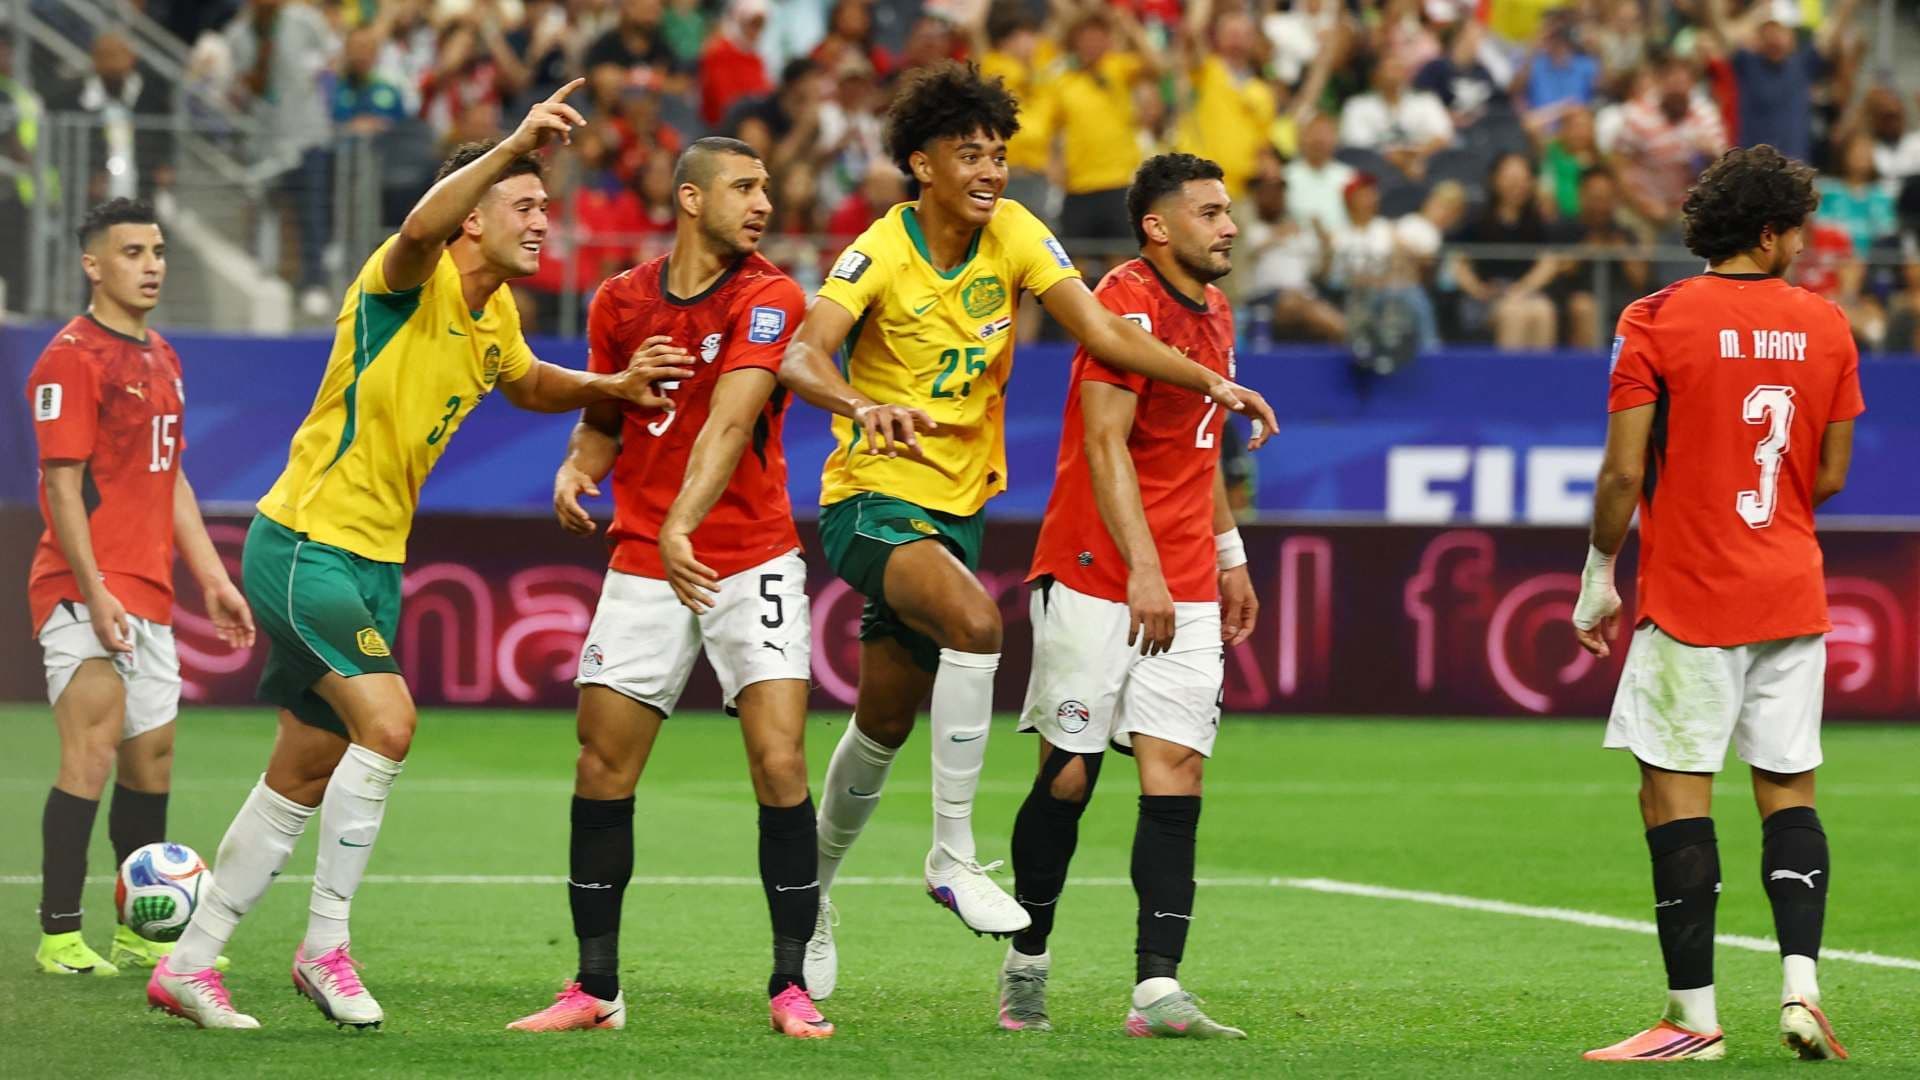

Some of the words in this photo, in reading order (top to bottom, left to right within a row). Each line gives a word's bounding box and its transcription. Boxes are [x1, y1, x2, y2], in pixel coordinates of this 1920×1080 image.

[1718, 329, 1746, 359] M.
[1752, 330, 1807, 361] HANY
[931, 347, 986, 398] 25
[150, 414, 178, 472] 15
[426, 395, 461, 445] 3
[1195, 395, 1218, 449] 2
[1736, 385, 1796, 529] 3
[1386, 446, 1640, 524] FIF
[760, 574, 783, 628] 5
